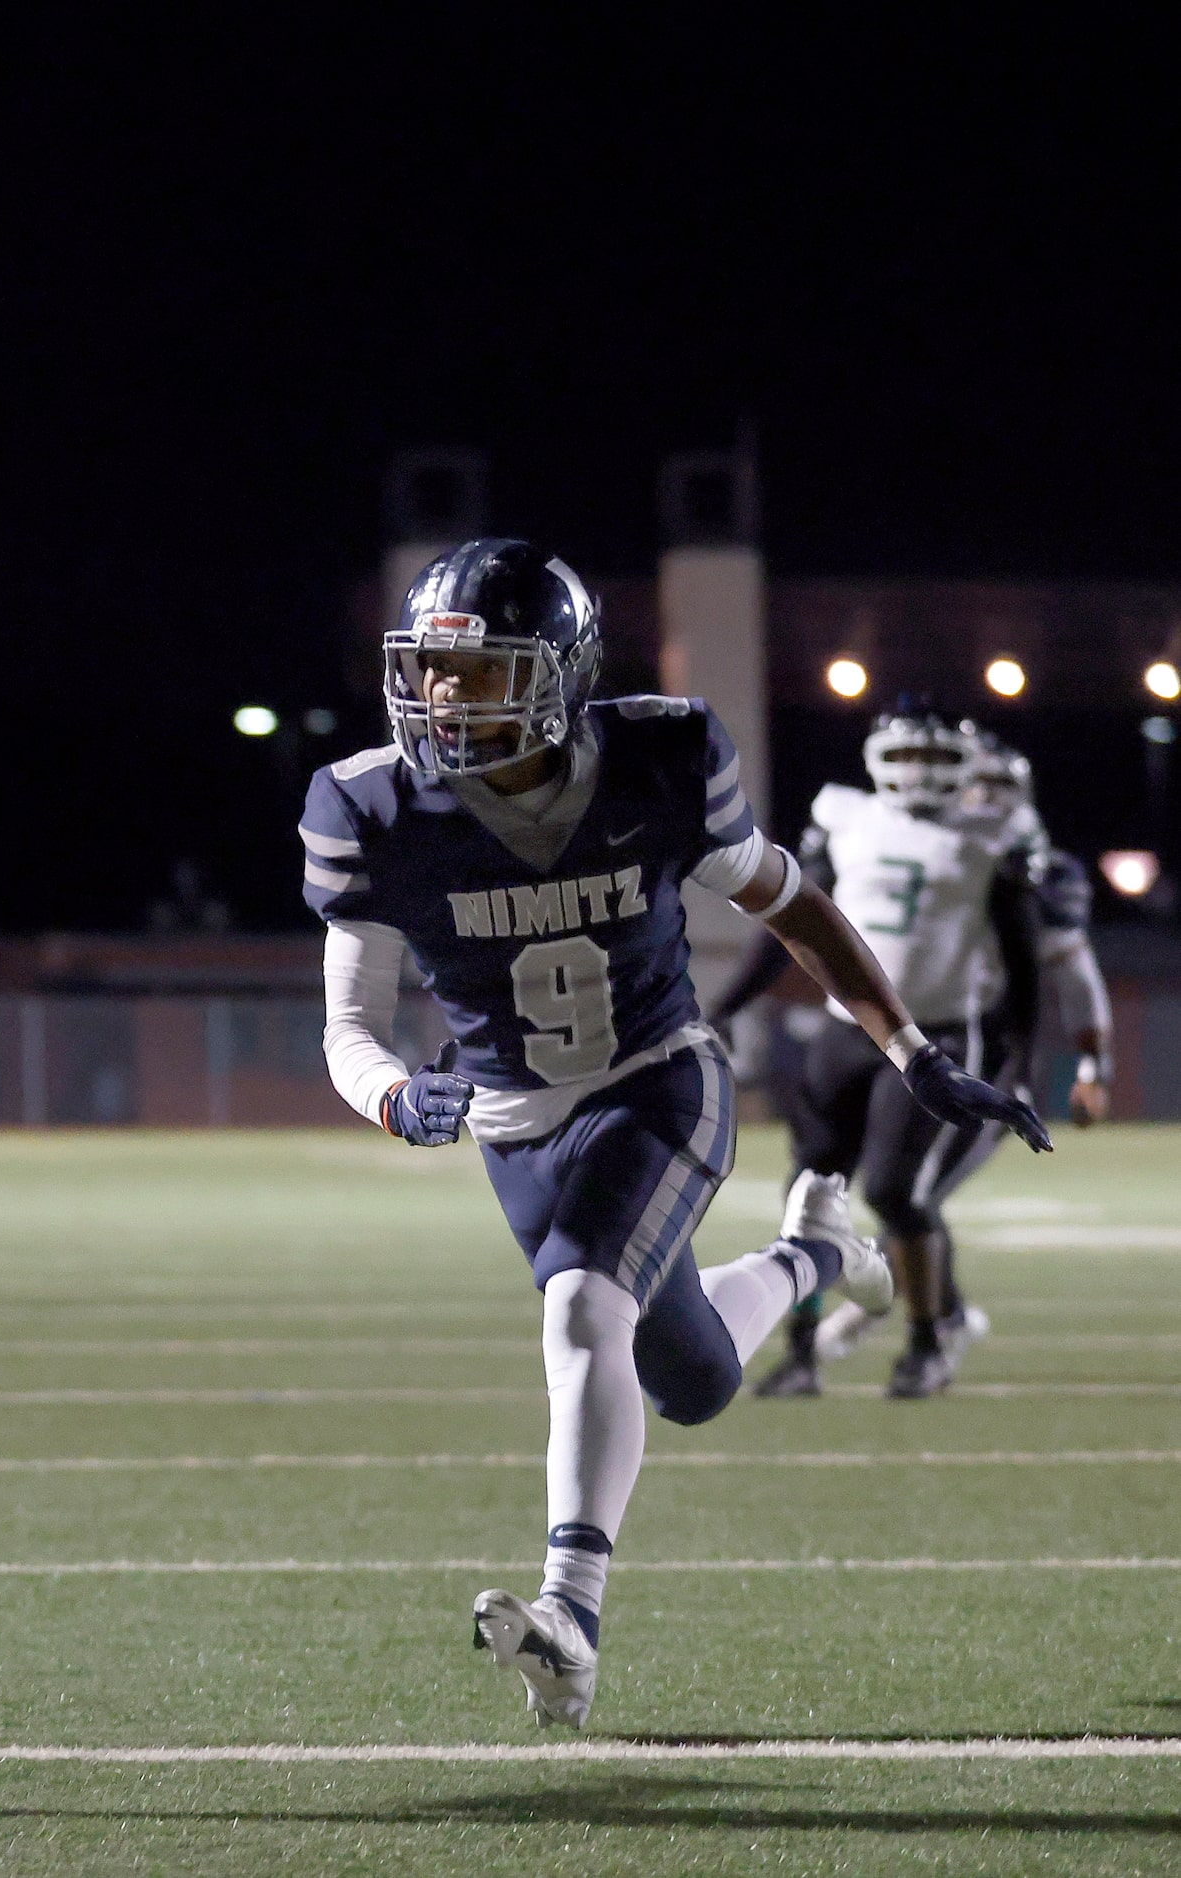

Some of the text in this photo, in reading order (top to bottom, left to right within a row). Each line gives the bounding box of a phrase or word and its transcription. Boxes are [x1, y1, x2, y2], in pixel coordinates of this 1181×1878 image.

[447, 864, 647, 937] NIMITZ
[865, 855, 925, 937] 3
[510, 935, 618, 1086] 9
